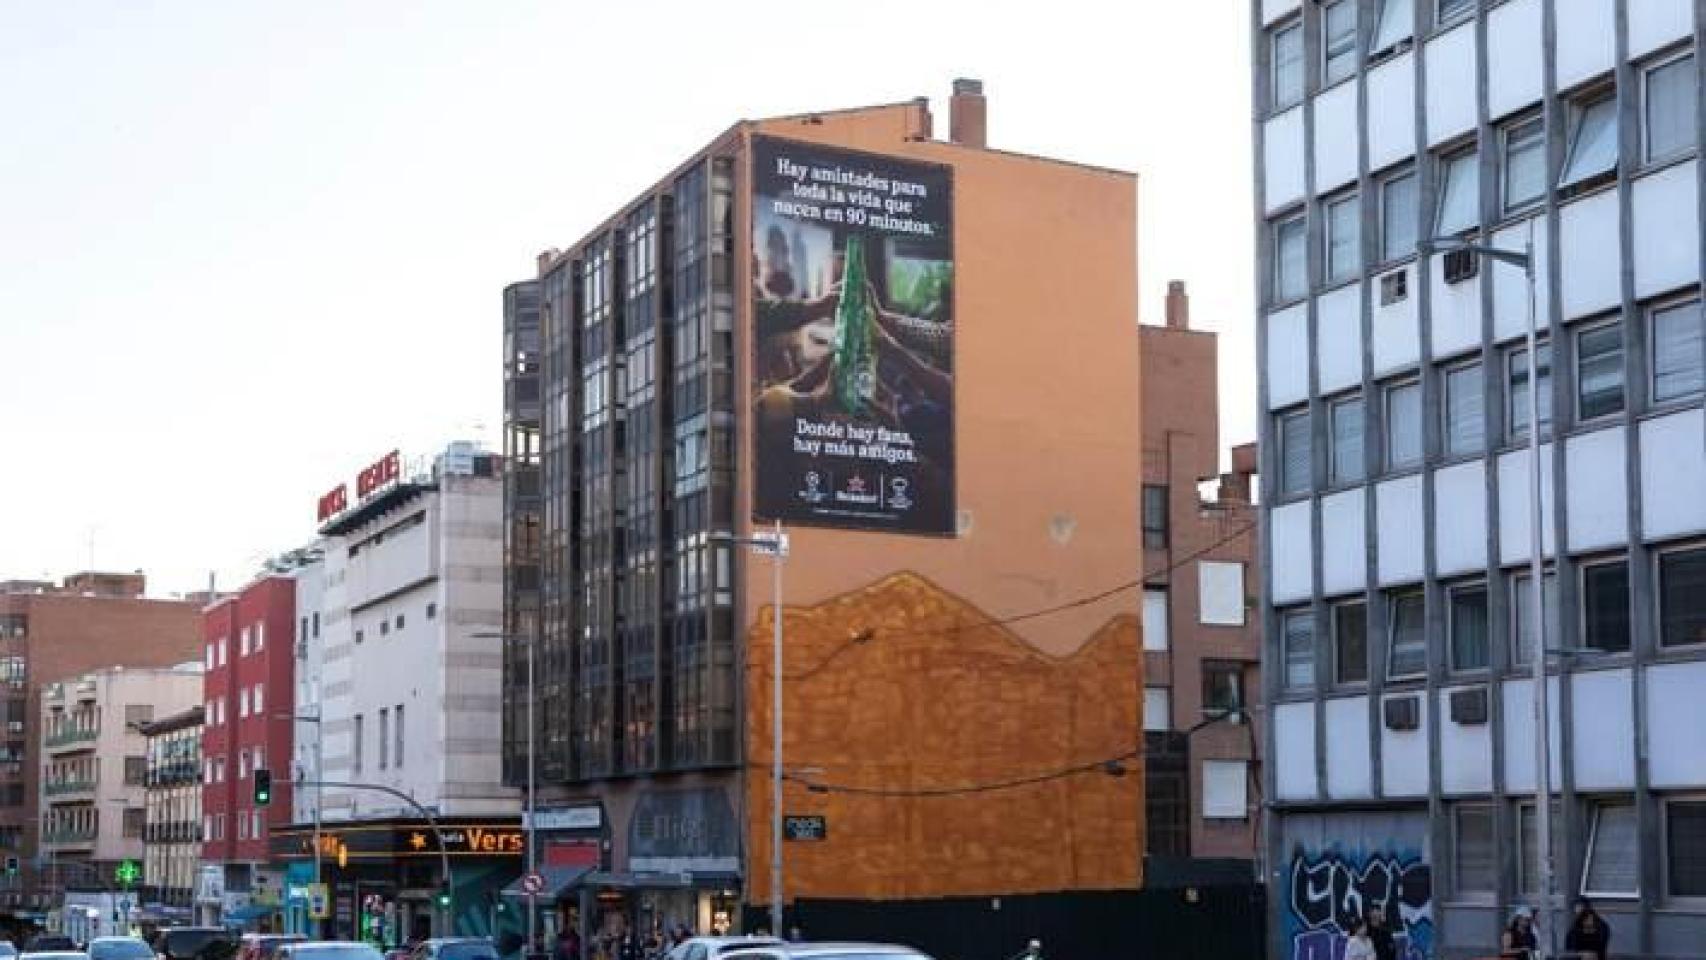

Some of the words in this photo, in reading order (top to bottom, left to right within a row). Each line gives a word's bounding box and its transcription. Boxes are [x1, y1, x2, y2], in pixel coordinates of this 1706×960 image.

[777, 157, 808, 180] Hay
[811, 166, 889, 191] amistades
[892, 180, 927, 198] para
[793, 182, 826, 201] toda
[830, 185, 845, 203] la
[850, 189, 881, 208] vida
[885, 199, 913, 215] que
[774, 201, 821, 219] nacen
[824, 210, 843, 222] en
[846, 208, 866, 225] 90
[869, 213, 934, 235] minutos.
[796, 418, 845, 438] Donde
[847, 423, 874, 444] hay
[793, 435, 821, 457] hay
[824, 440, 855, 456] más
[858, 443, 918, 463] amigos.
